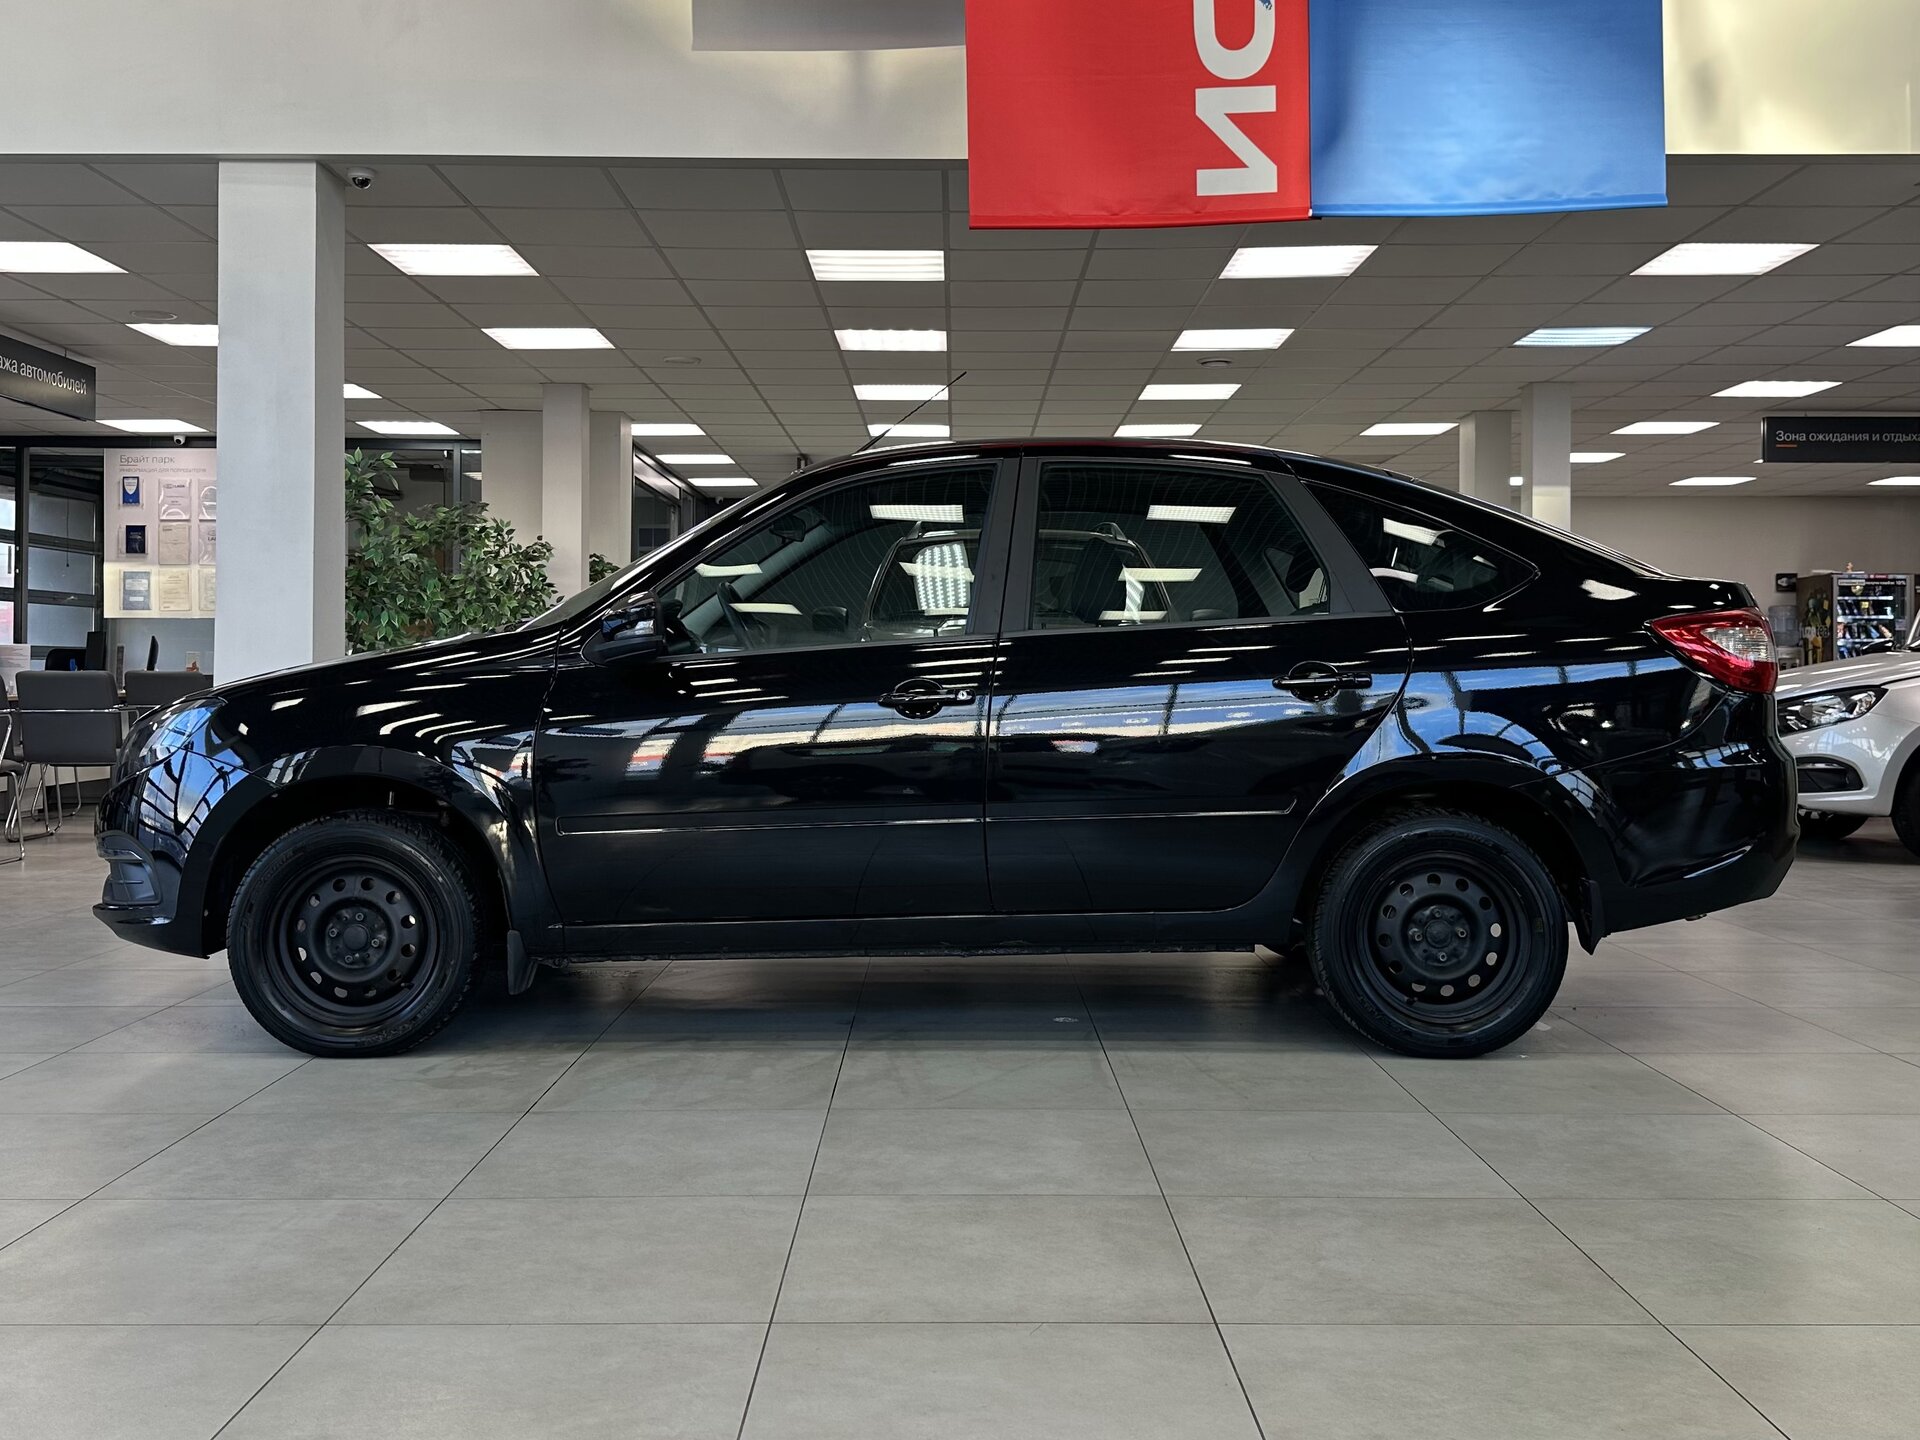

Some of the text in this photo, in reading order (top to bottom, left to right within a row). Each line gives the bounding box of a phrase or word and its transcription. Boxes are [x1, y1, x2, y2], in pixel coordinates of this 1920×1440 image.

[20, 362, 87, 395] автомобилей
[1775, 430, 1806, 442] Зона
[1808, 432, 1869, 443] ожидания
[1872, 433, 1880, 441] и
[119, 454, 176, 465] Брайт парк
